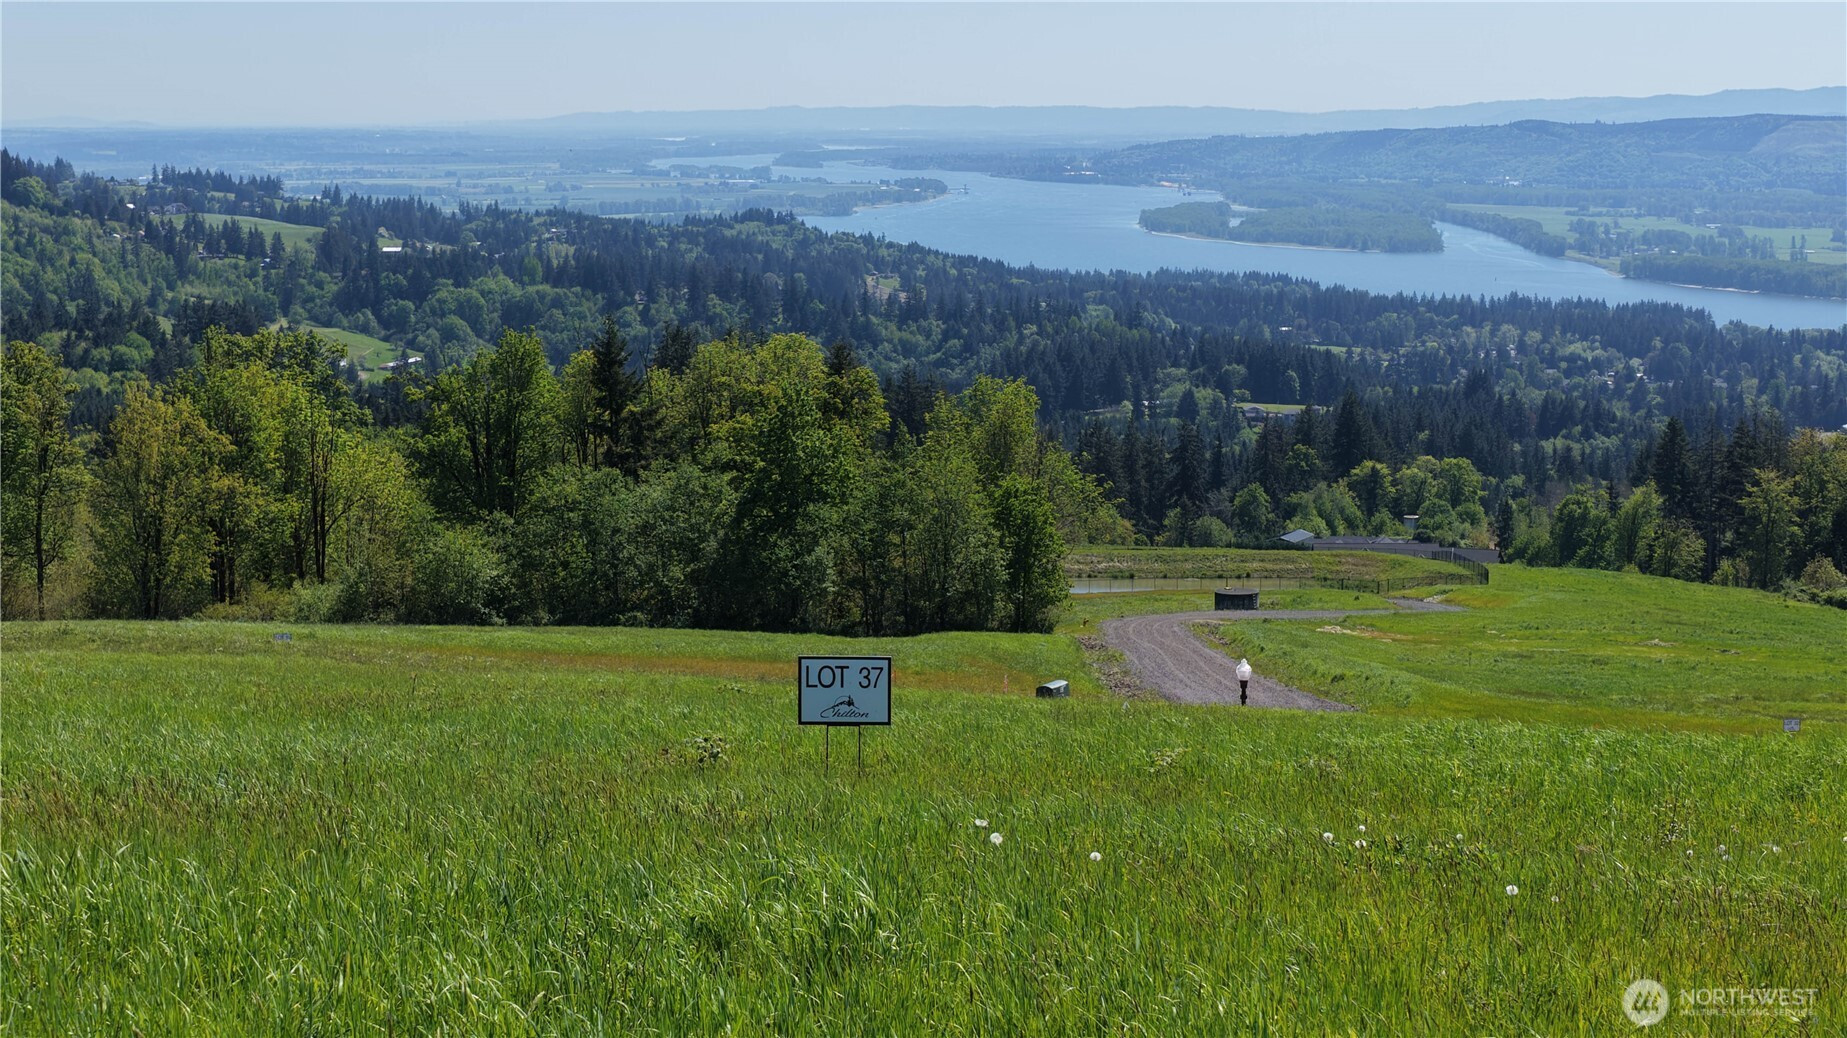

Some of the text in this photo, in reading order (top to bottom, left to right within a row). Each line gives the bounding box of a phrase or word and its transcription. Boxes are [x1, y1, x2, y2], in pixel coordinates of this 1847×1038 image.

[805, 665, 884, 689] LOT 37
[819, 706, 870, 719] Chilton
